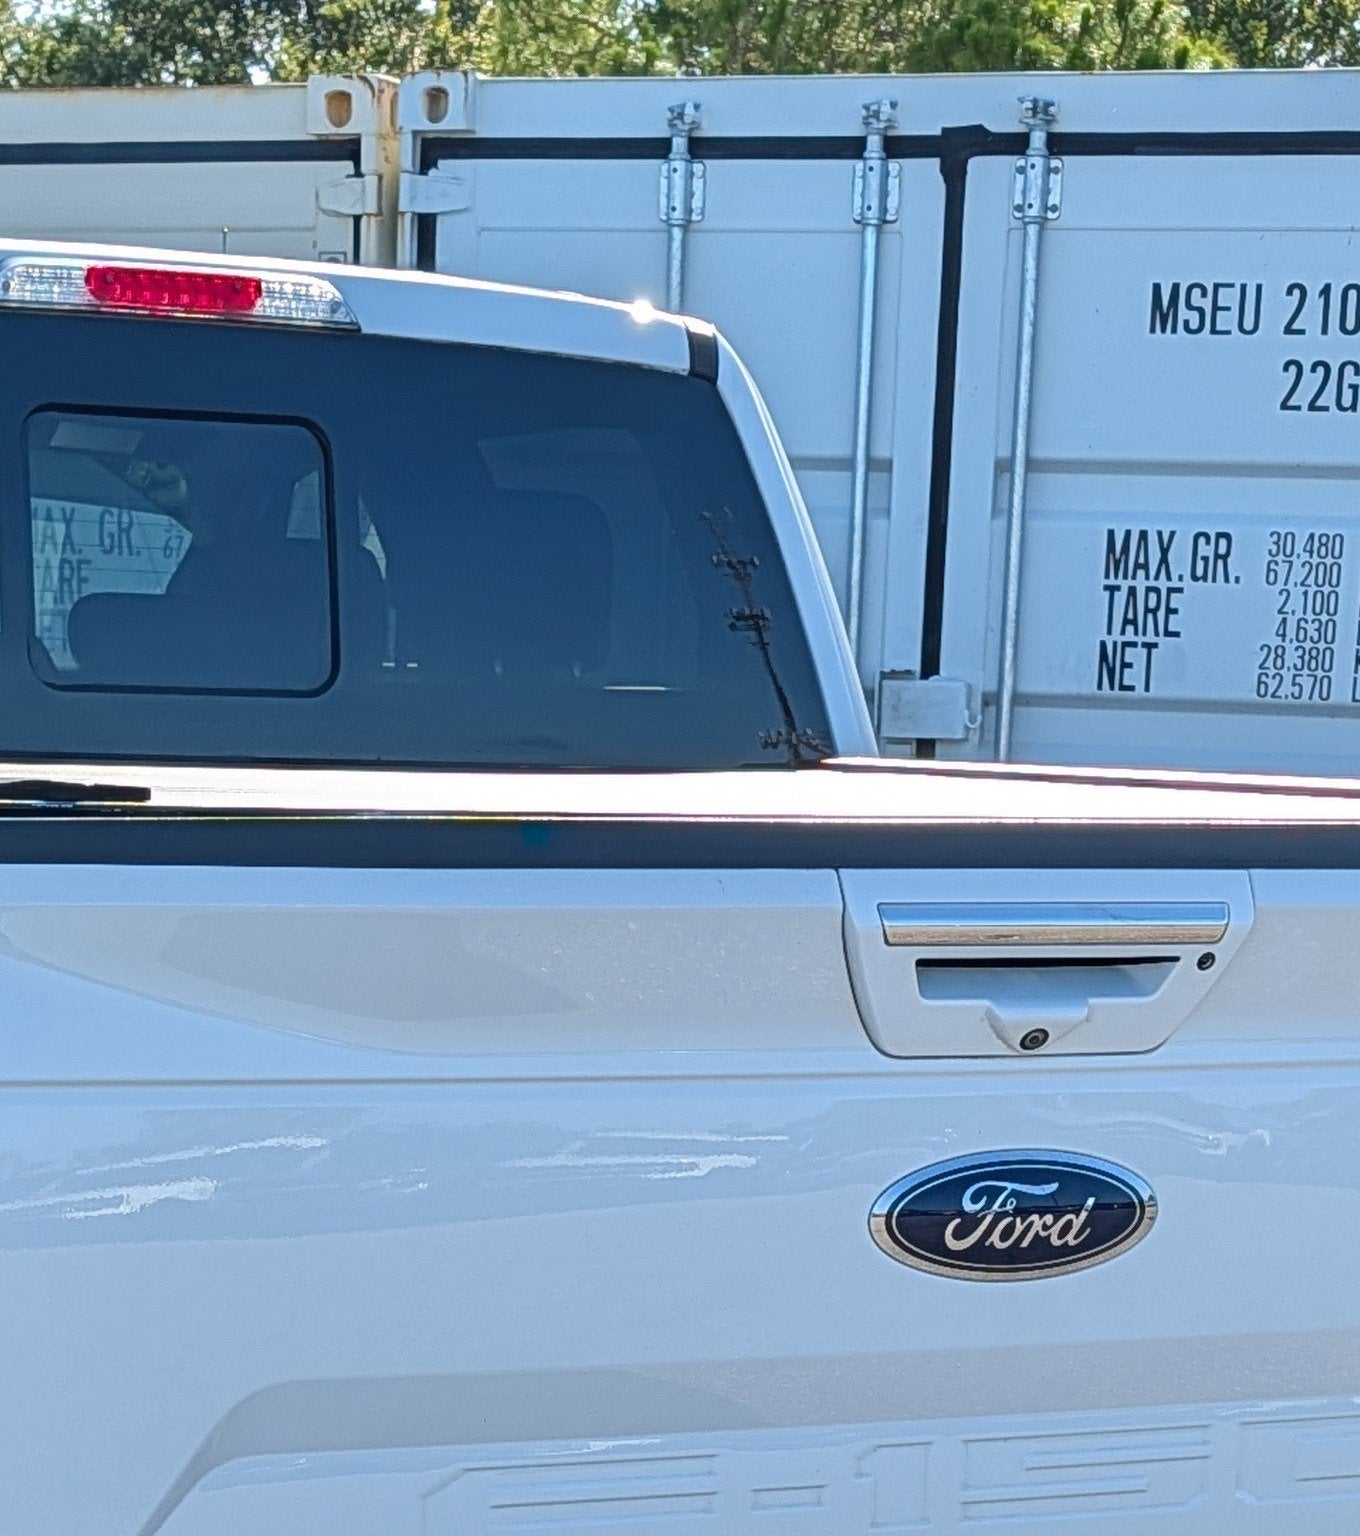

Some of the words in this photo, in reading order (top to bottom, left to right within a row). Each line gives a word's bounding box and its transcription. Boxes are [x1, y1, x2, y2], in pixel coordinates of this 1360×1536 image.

[1148, 281, 1264, 336] MSEU
[1103, 528, 1242, 585] MAX.GR.
[1103, 584, 1184, 638] TARE
[1097, 640, 1158, 693] NET
[943, 1179, 1097, 1251] Ford
